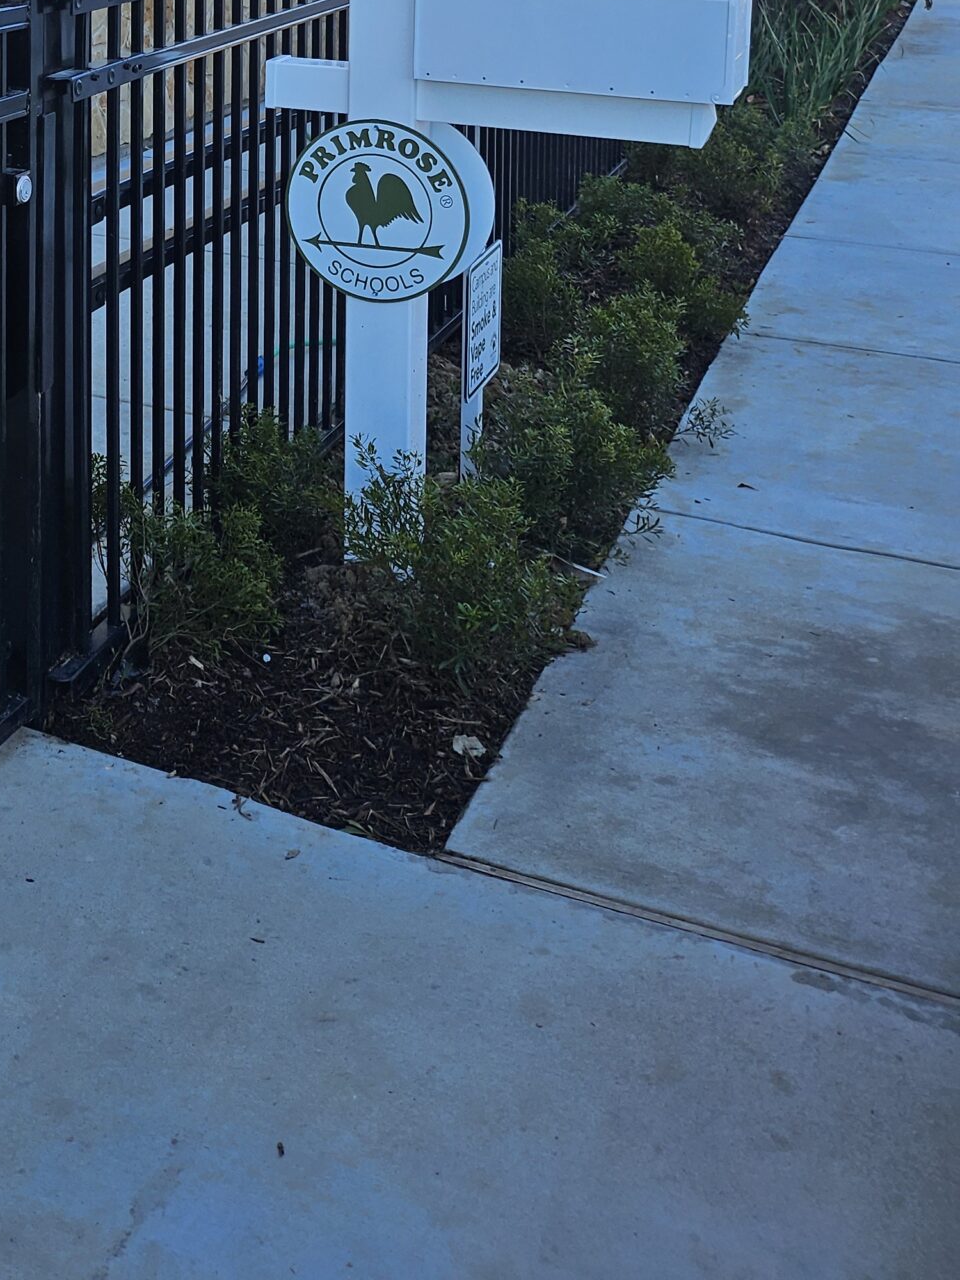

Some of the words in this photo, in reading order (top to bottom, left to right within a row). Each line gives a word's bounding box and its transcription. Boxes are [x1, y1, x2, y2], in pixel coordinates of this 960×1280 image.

[299, 128, 453, 193] PRIMROSE
[327, 260, 425, 293] SCHOOLS
[471, 308, 491, 341] Smoke
[492, 300, 497, 319] &
[471, 338, 486, 363] Vape
[470, 362, 484, 388] Free
